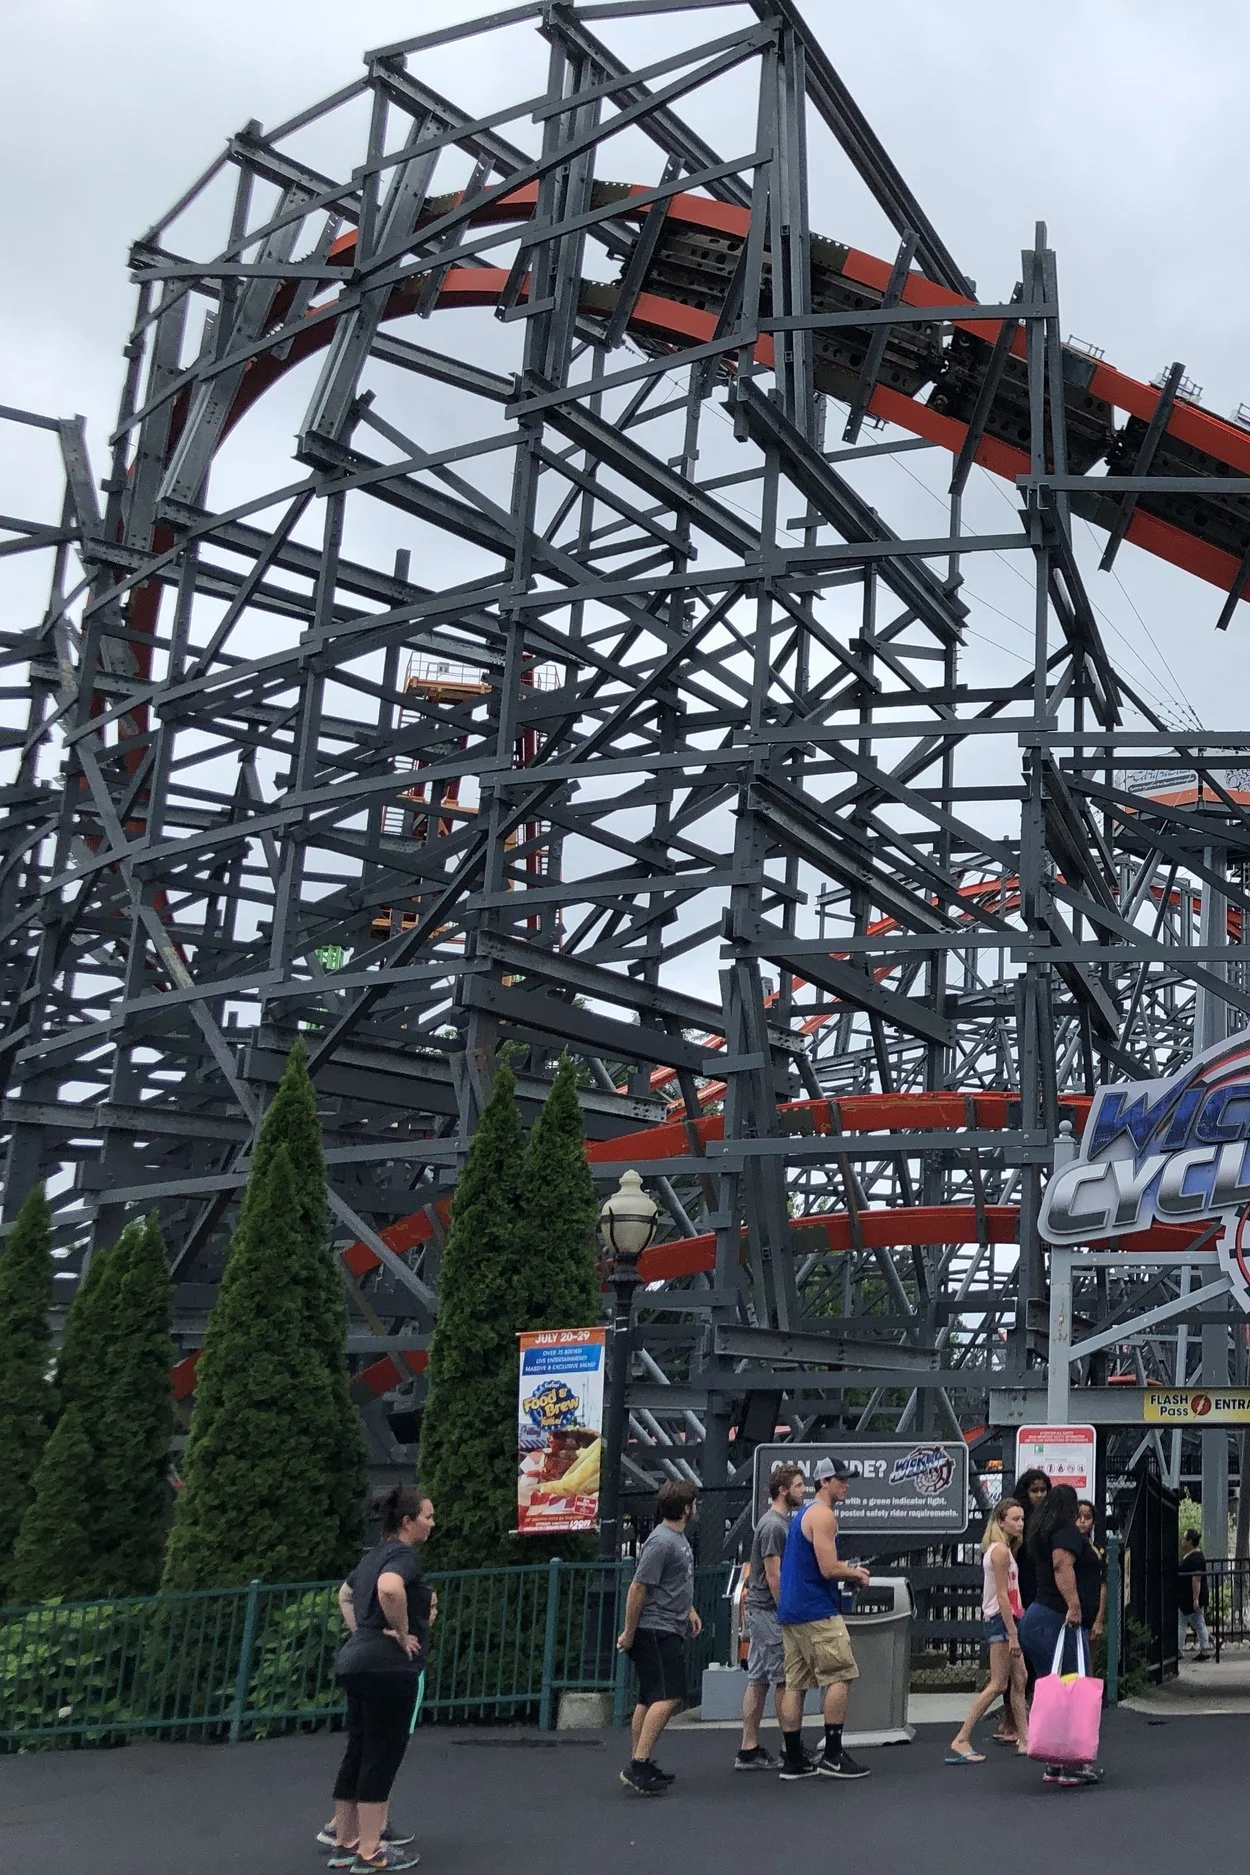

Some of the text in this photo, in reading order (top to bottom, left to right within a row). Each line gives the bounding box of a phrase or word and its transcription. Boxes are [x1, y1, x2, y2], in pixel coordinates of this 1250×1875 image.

[534, 1330, 591, 1344] JULY 20-29
[523, 1389, 557, 1412] Food
[1150, 1394, 1189, 1406] FLASH
[544, 1397, 579, 1417] Brew
[1160, 1405, 1189, 1417] Pass
[845, 1497, 861, 1505] with
[868, 1498, 891, 1506] green
[892, 1497, 926, 1505] indicator
[840, 1509, 865, 1519] posted
[866, 1509, 889, 1519] safety
[890, 1509, 908, 1517] rider
